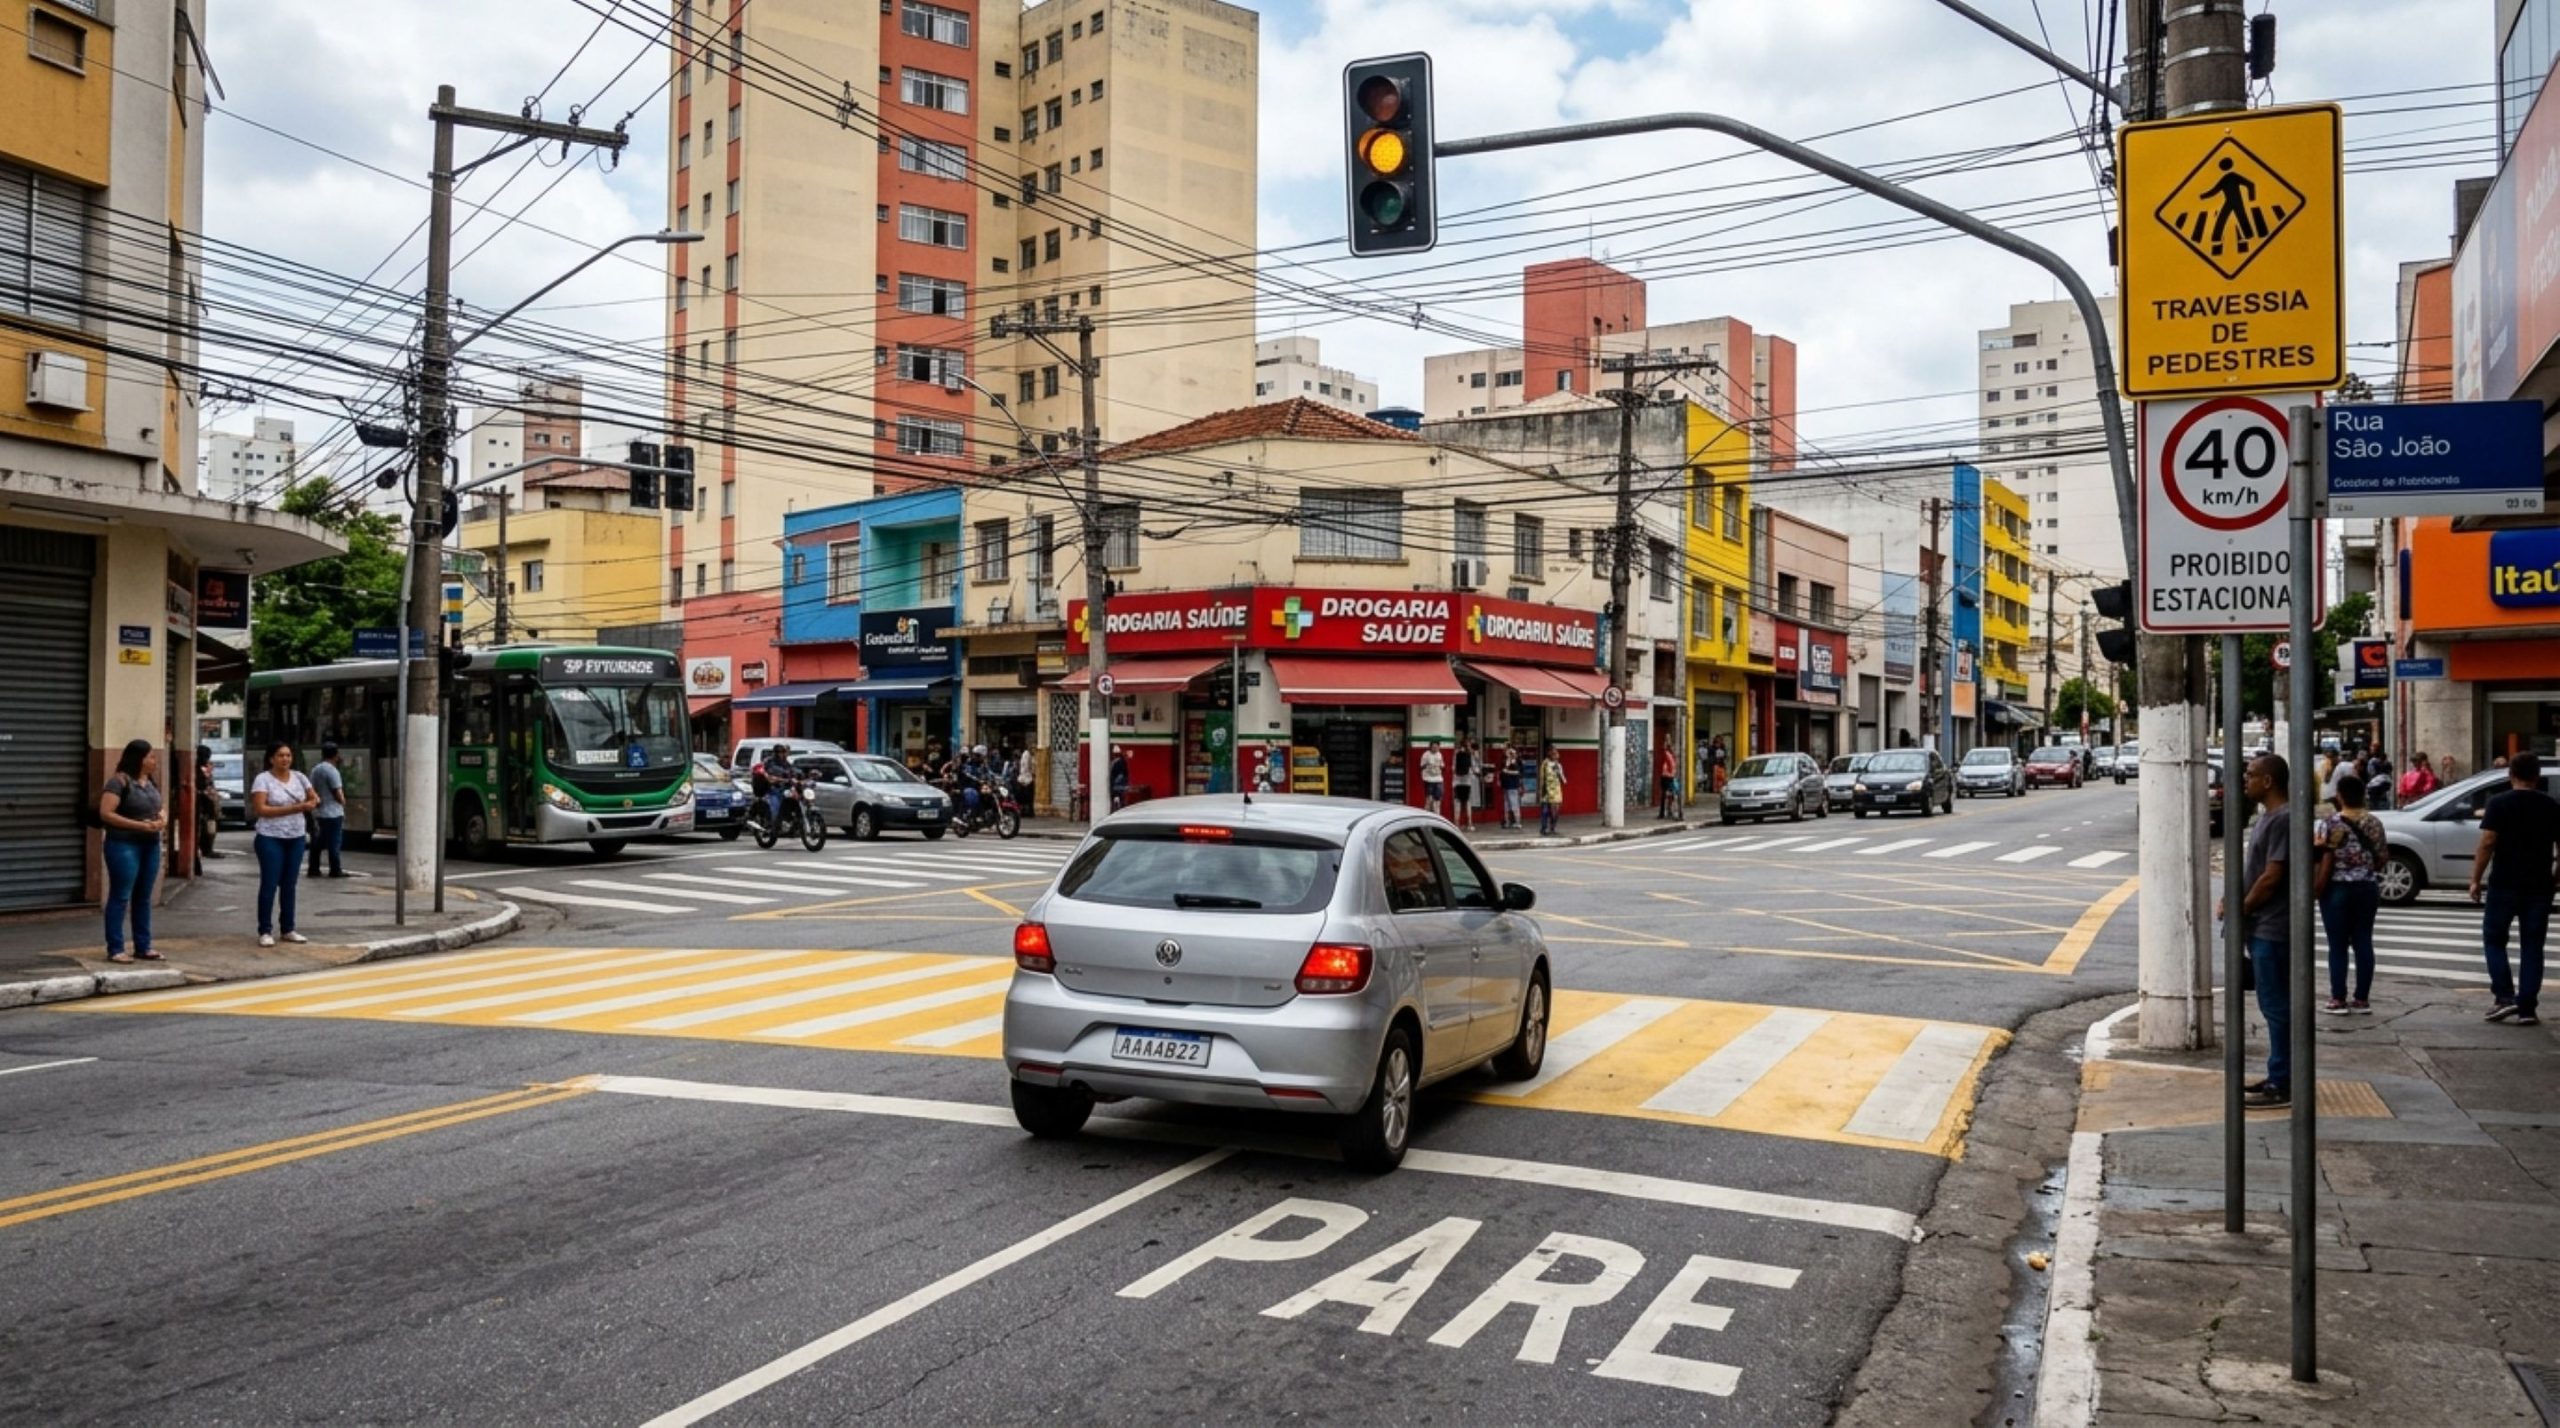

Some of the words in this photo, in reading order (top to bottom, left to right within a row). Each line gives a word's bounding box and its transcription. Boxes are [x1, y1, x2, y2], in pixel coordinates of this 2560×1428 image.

[2152, 289, 2309, 320] TRAVESSIA
[2211, 322, 2249, 344] DE
[2147, 345, 2315, 375] PEDESTRES
[2334, 411, 2384, 432] Rua
[2185, 426, 2276, 479] 40
[2391, 435, 2451, 457] João
[2202, 486, 2260, 506] km/h
[2170, 551, 2291, 577] PROIBIDO
[2495, 561, 2560, 595] Itaú
[1321, 598, 1450, 619] DROGARIA
[2153, 585, 2291, 611] ESTACIONA
[1104, 610, 1182, 633] ROGARIA
[1187, 601, 1247, 629] SAÚDE
[1362, 620, 1446, 643] SAÚDE
[1115, 1197, 1803, 1397] PARE
